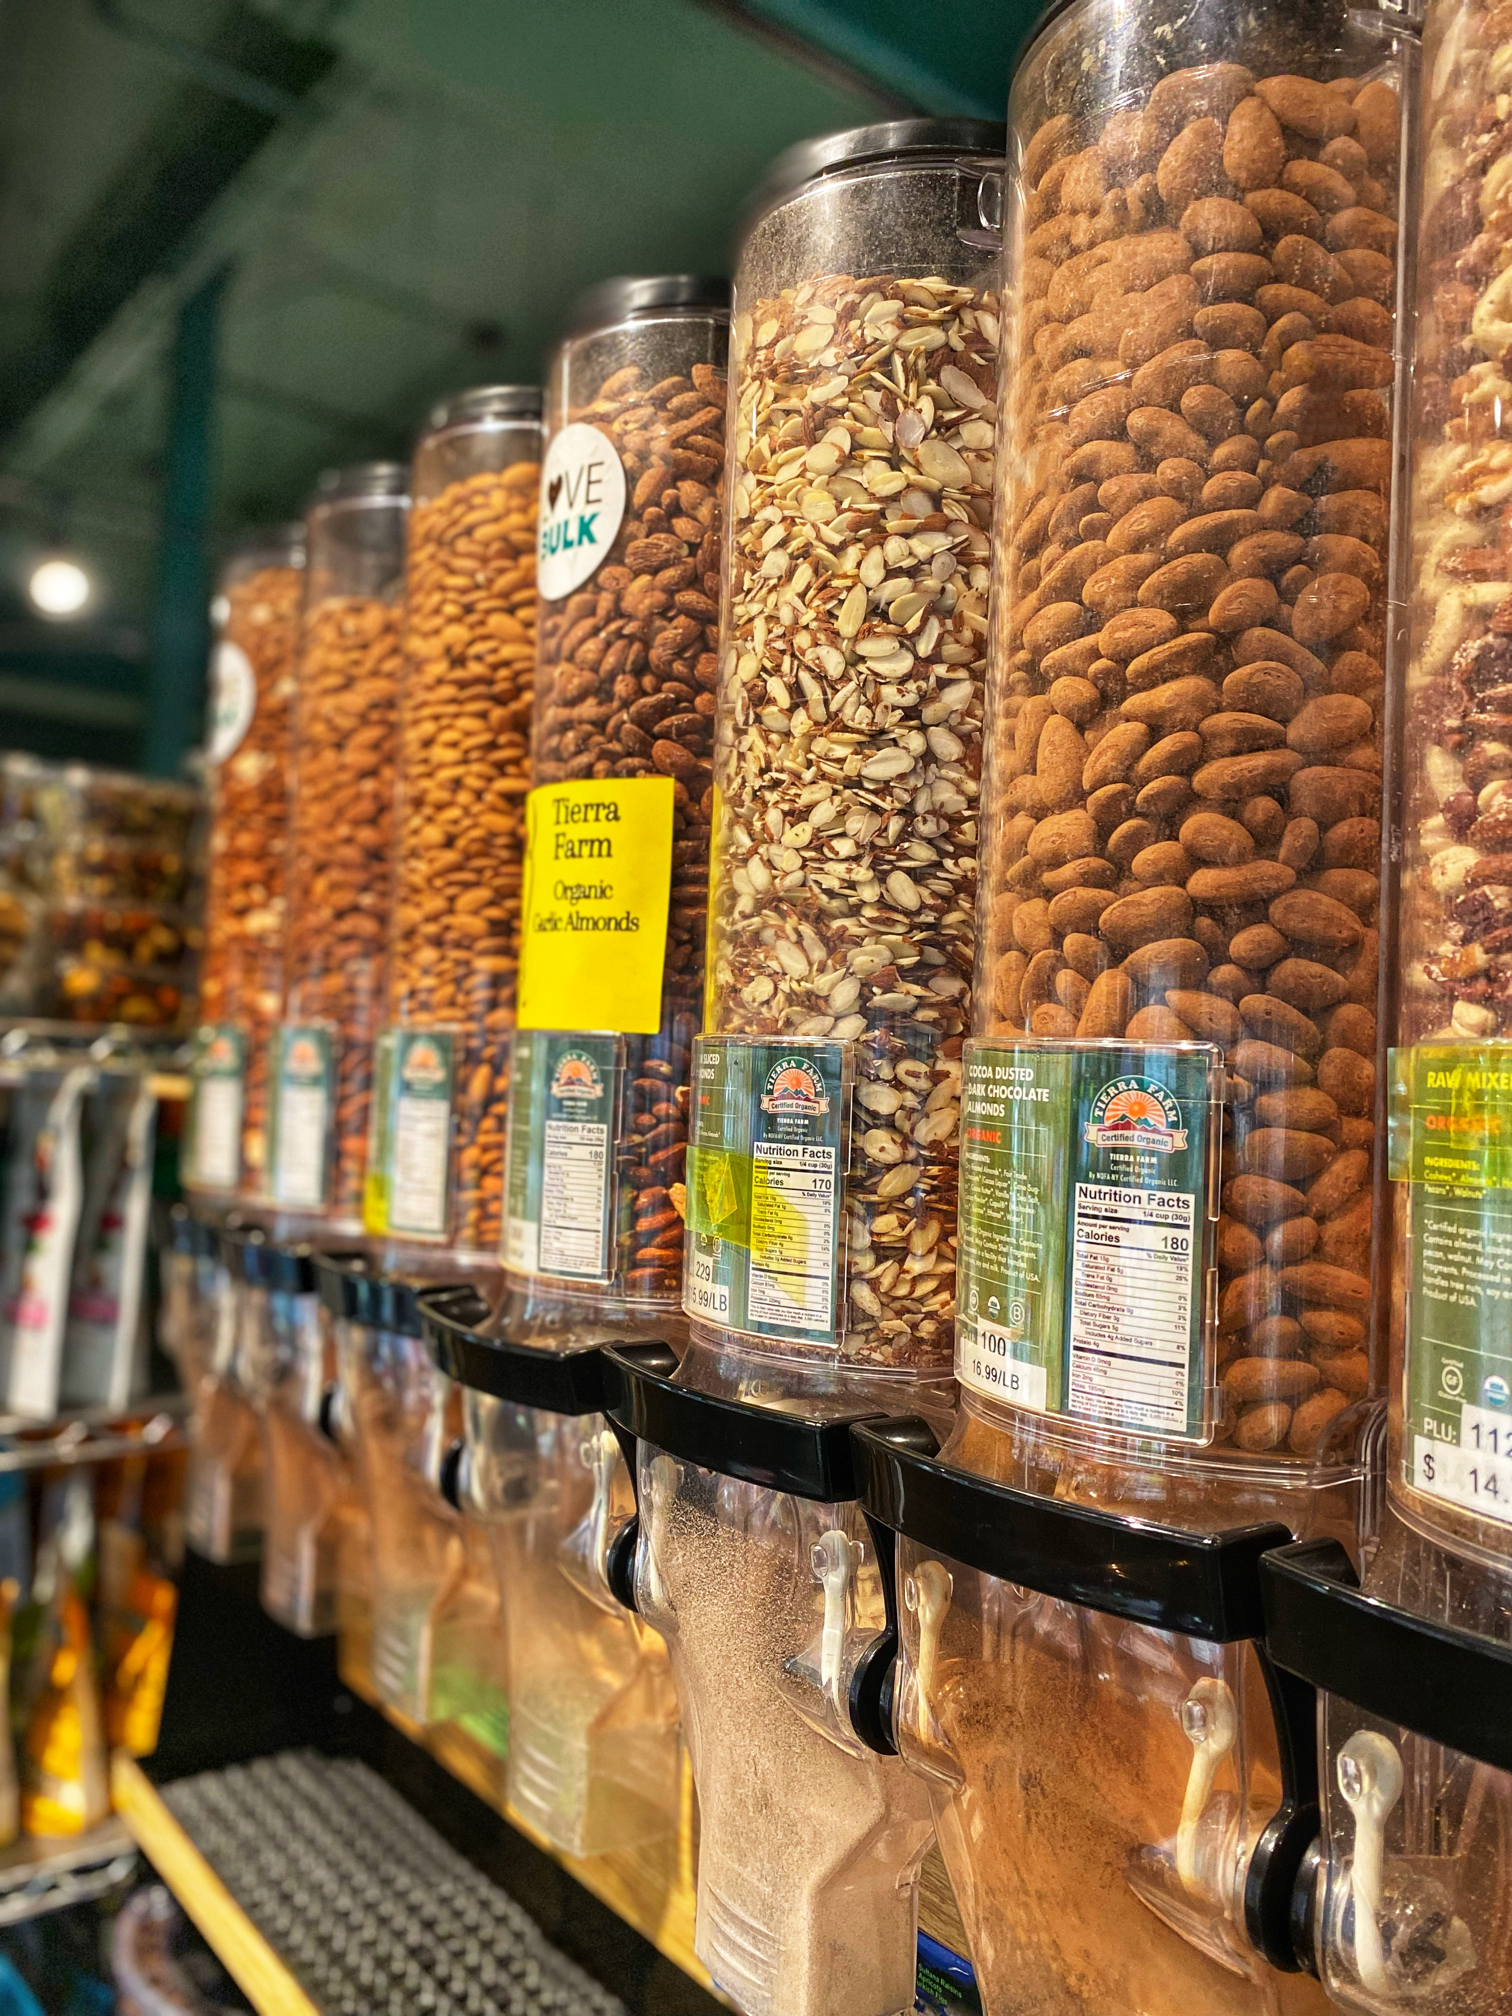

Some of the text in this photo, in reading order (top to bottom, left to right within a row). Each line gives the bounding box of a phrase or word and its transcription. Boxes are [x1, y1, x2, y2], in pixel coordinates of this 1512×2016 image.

[552, 797, 621, 826] Tierra
[554, 832, 613, 861] Farm
[553, 880, 613, 906] Organic
[565, 910, 640, 933] Almonds
[766, 1059, 823, 1093] TIERRA FARM
[969, 1064, 1034, 1082] COCOA DUSTED
[1427, 1071, 1512, 1090] RAW MIXE
[967, 1084, 1050, 1103] DARK CHOCOLATE
[1094, 1079, 1179, 1123] TIERRA FARM
[771, 1101, 818, 1112] Certified Organic
[967, 1101, 1006, 1118] ALMONDS
[547, 1123, 605, 1135] Nutrition Facts
[966, 1128, 1002, 1145] ORGANIC
[1101, 1132, 1169, 1148] Certified Organic
[588, 1149, 604, 1160] 180
[755, 1144, 833, 1160] Nutrition Facts
[1109, 1153, 1158, 1164] TIERRA FARM
[1110, 1163, 1156, 1175] Certified Organic
[754, 1176, 832, 1190] Calories 170
[1088, 1171, 1096, 1180] By
[1120, 1173, 1143, 1184] Certified
[1144, 1176, 1167, 1186] Organic
[1078, 1185, 1191, 1210] Nutrition Facts
[1078, 1203, 1102, 1213] Serving
[1104, 1206, 1118, 1214] size
[1143, 1210, 1154, 1218] 1/4
[1171, 1213, 1191, 1223] (30g)
[1077, 1220, 1097, 1229] Amount
[1108, 1224, 1130, 1233] serving
[1076, 1228, 1190, 1251] Calories 180
[1423, 1233, 1453, 1247] Contains
[1076, 1251, 1089, 1260] Total
[1153, 1253, 1169, 1262] Daily
[695, 1261, 711, 1281] 229
[1081, 1262, 1106, 1271] Saturated
[1106, 1265, 1116, 1273] Fat
[1081, 1271, 1095, 1280] Trans
[1025, 1272, 1041, 1283] USA.
[1074, 1281, 1106, 1291] Cholesterol
[1074, 1290, 1095, 1299] Sodium
[1074, 1299, 1087, 1307] Total
[1087, 1301, 1126, 1313] Carbohydrate
[1079, 1309, 1098, 1319] Dietary
[1098, 1312, 1112, 1320] Fiber
[1092, 1321, 1111, 1331] Sugars
[981, 1331, 1007, 1357] 100
[1073, 1337, 1092, 1346] Protein
[1085, 1329, 1106, 1339] Includes
[1115, 1334, 1133, 1343] Added
[972, 1359, 1020, 1391] 16.99/LB
[1072, 1363, 1092, 1372] Calcium
[1423, 1417, 1457, 1444] PLU:
[1423, 1453, 1436, 1481] $
[918, 1972, 943, 1994] Apricots
[940, 1978, 962, 1998] Raisins
